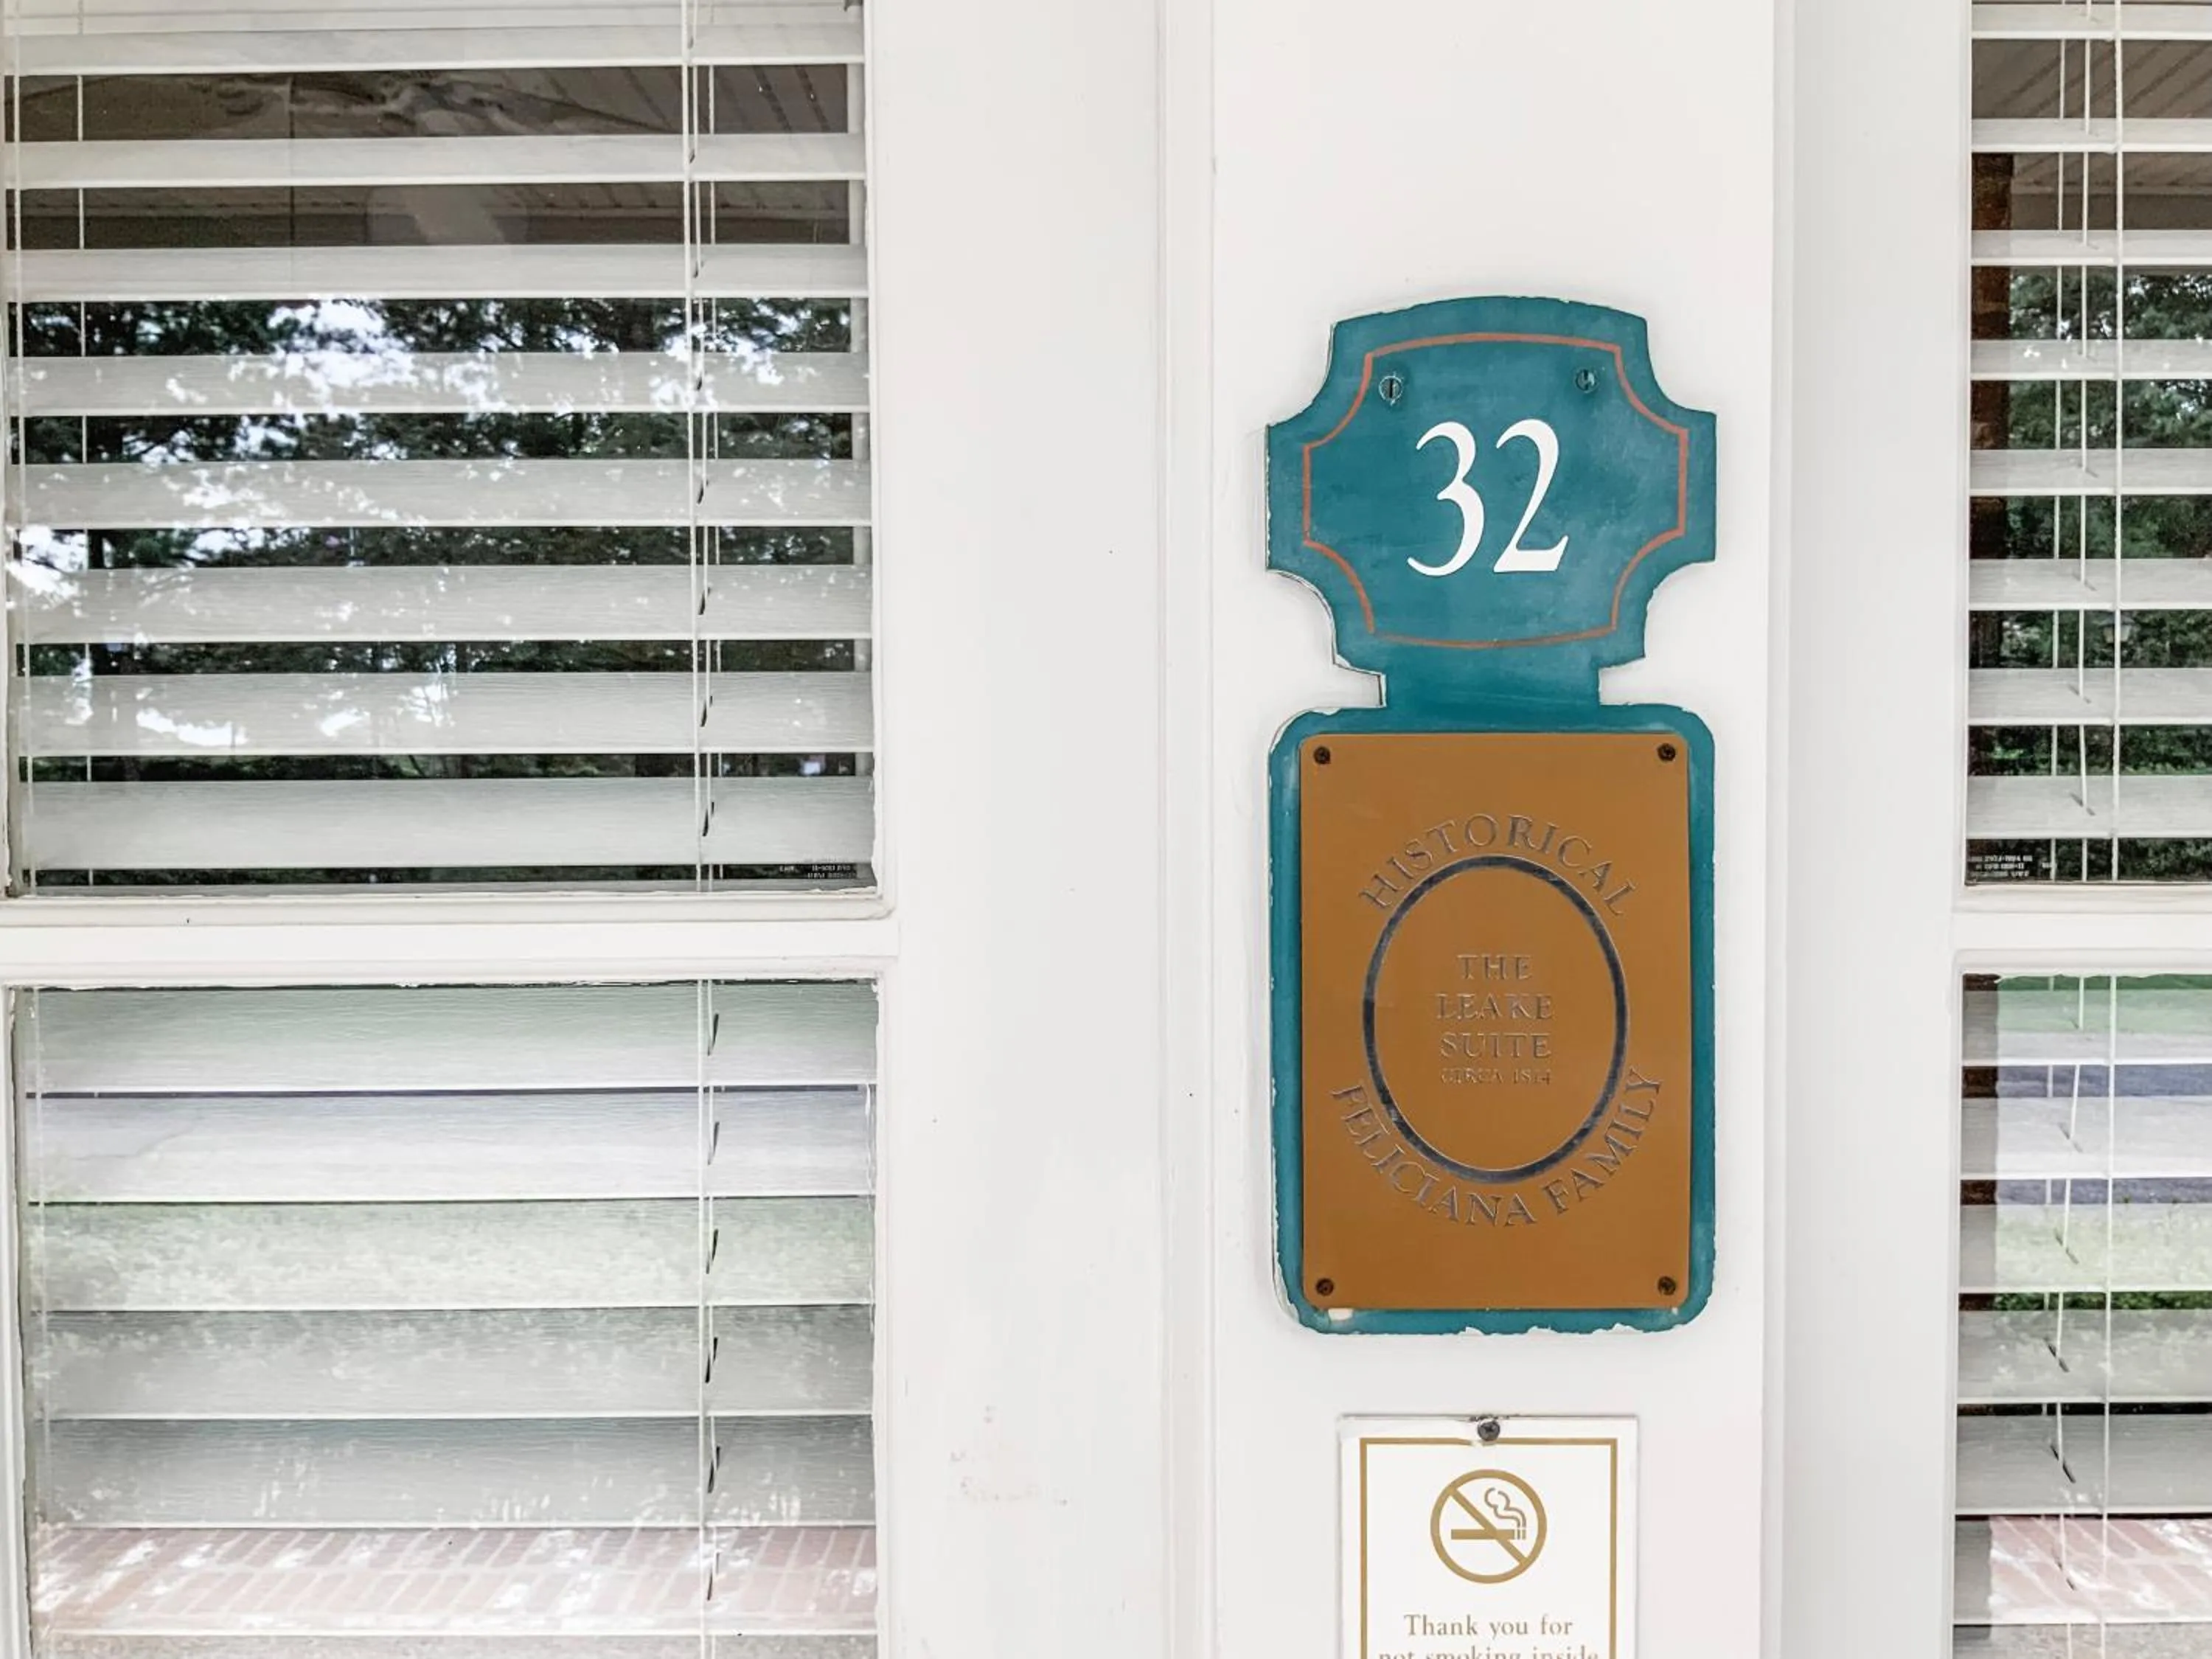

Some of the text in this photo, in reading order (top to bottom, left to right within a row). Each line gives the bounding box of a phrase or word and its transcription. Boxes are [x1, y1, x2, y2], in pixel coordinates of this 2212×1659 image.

[1408, 419, 1569, 577] 32
[1358, 813, 1638, 917] HISTORICAL
[1457, 954, 1533, 980] THE
[1435, 992, 1554, 1020] LEAKE
[1440, 1032, 1552, 1059] SUITE
[1330, 1066, 1663, 1227] FELICIANA FAMILY
[1403, 1613, 1573, 1641] Thank you for
